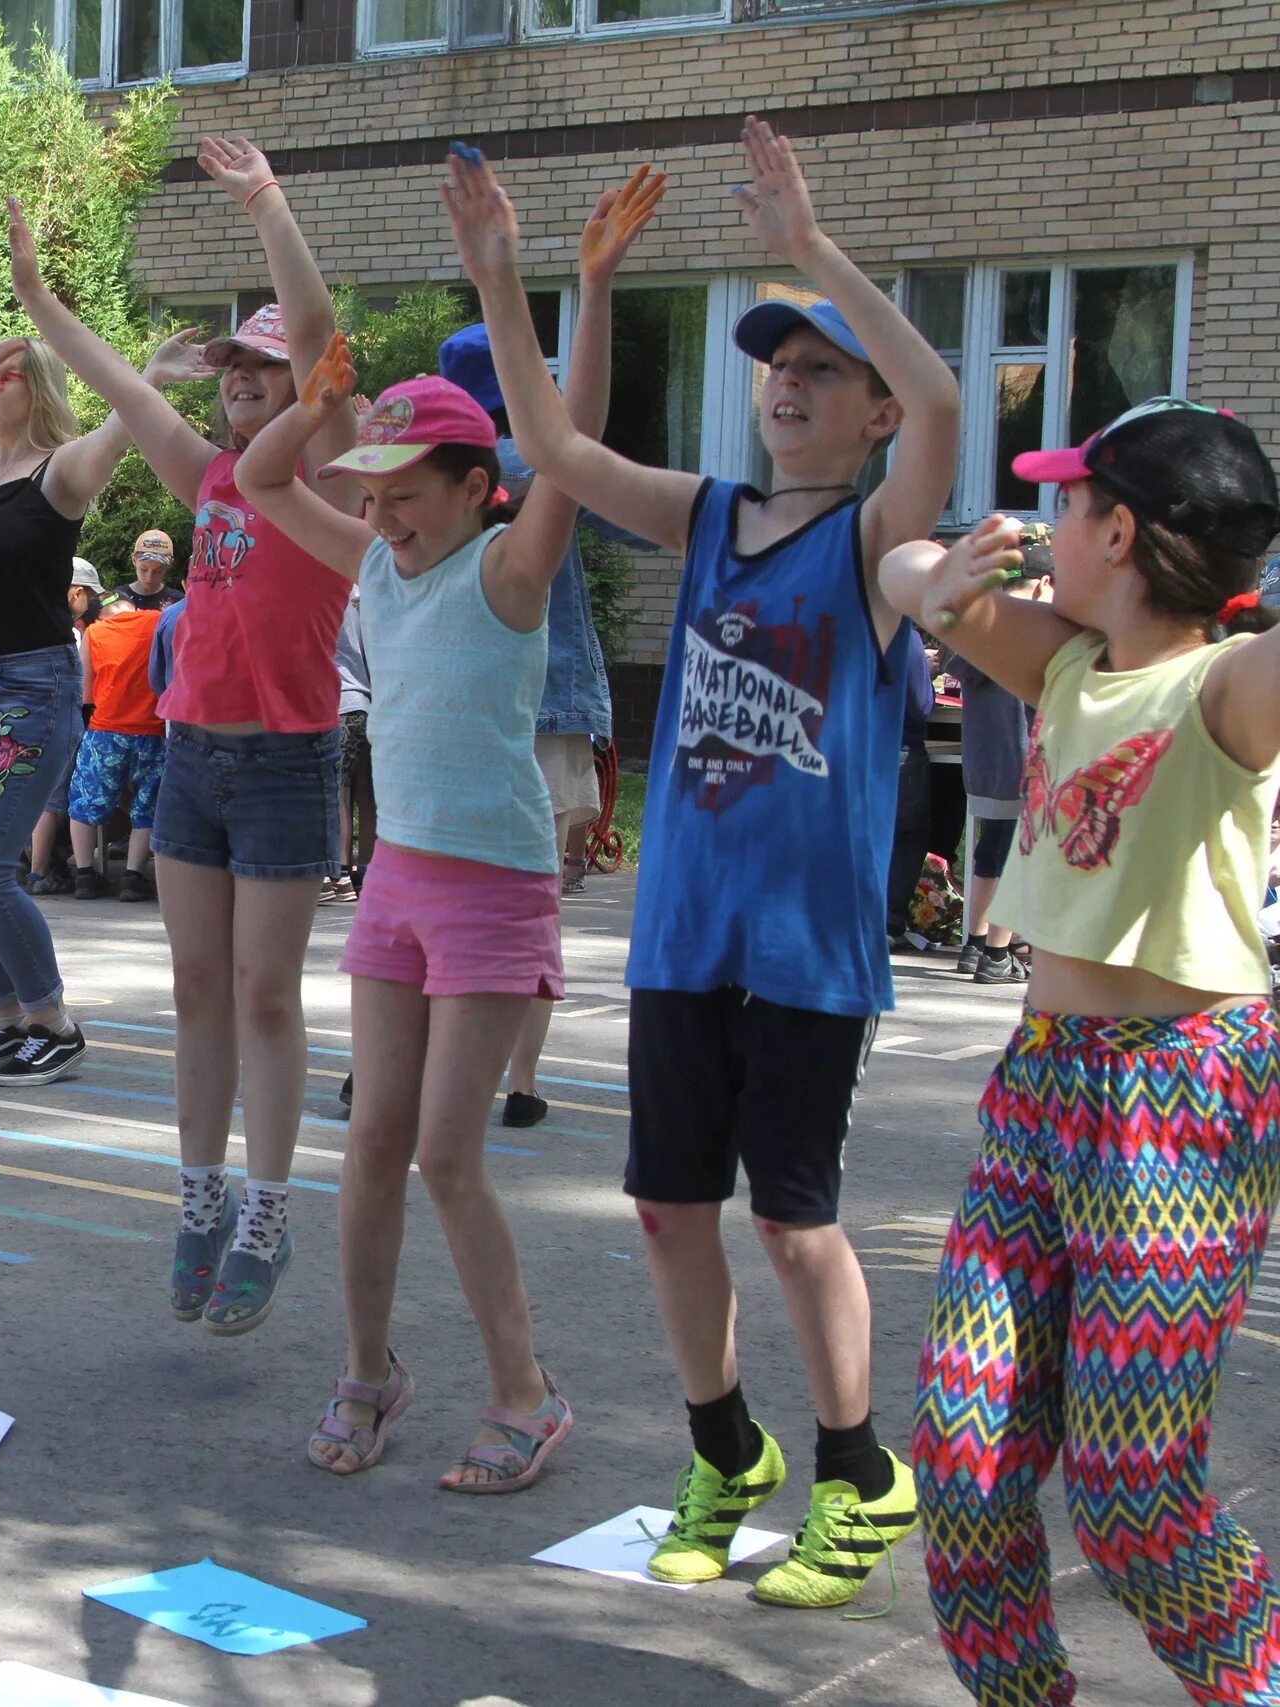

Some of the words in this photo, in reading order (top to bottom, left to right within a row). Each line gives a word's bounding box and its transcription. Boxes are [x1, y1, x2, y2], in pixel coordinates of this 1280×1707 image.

[693, 651, 799, 714] NATIONAL
[681, 685, 804, 753] BASEBALL
[688, 757, 703, 769] ONE
[706, 759, 723, 771] AND
[726, 760, 753, 772] ONLY
[797, 754, 823, 771] TEAM
